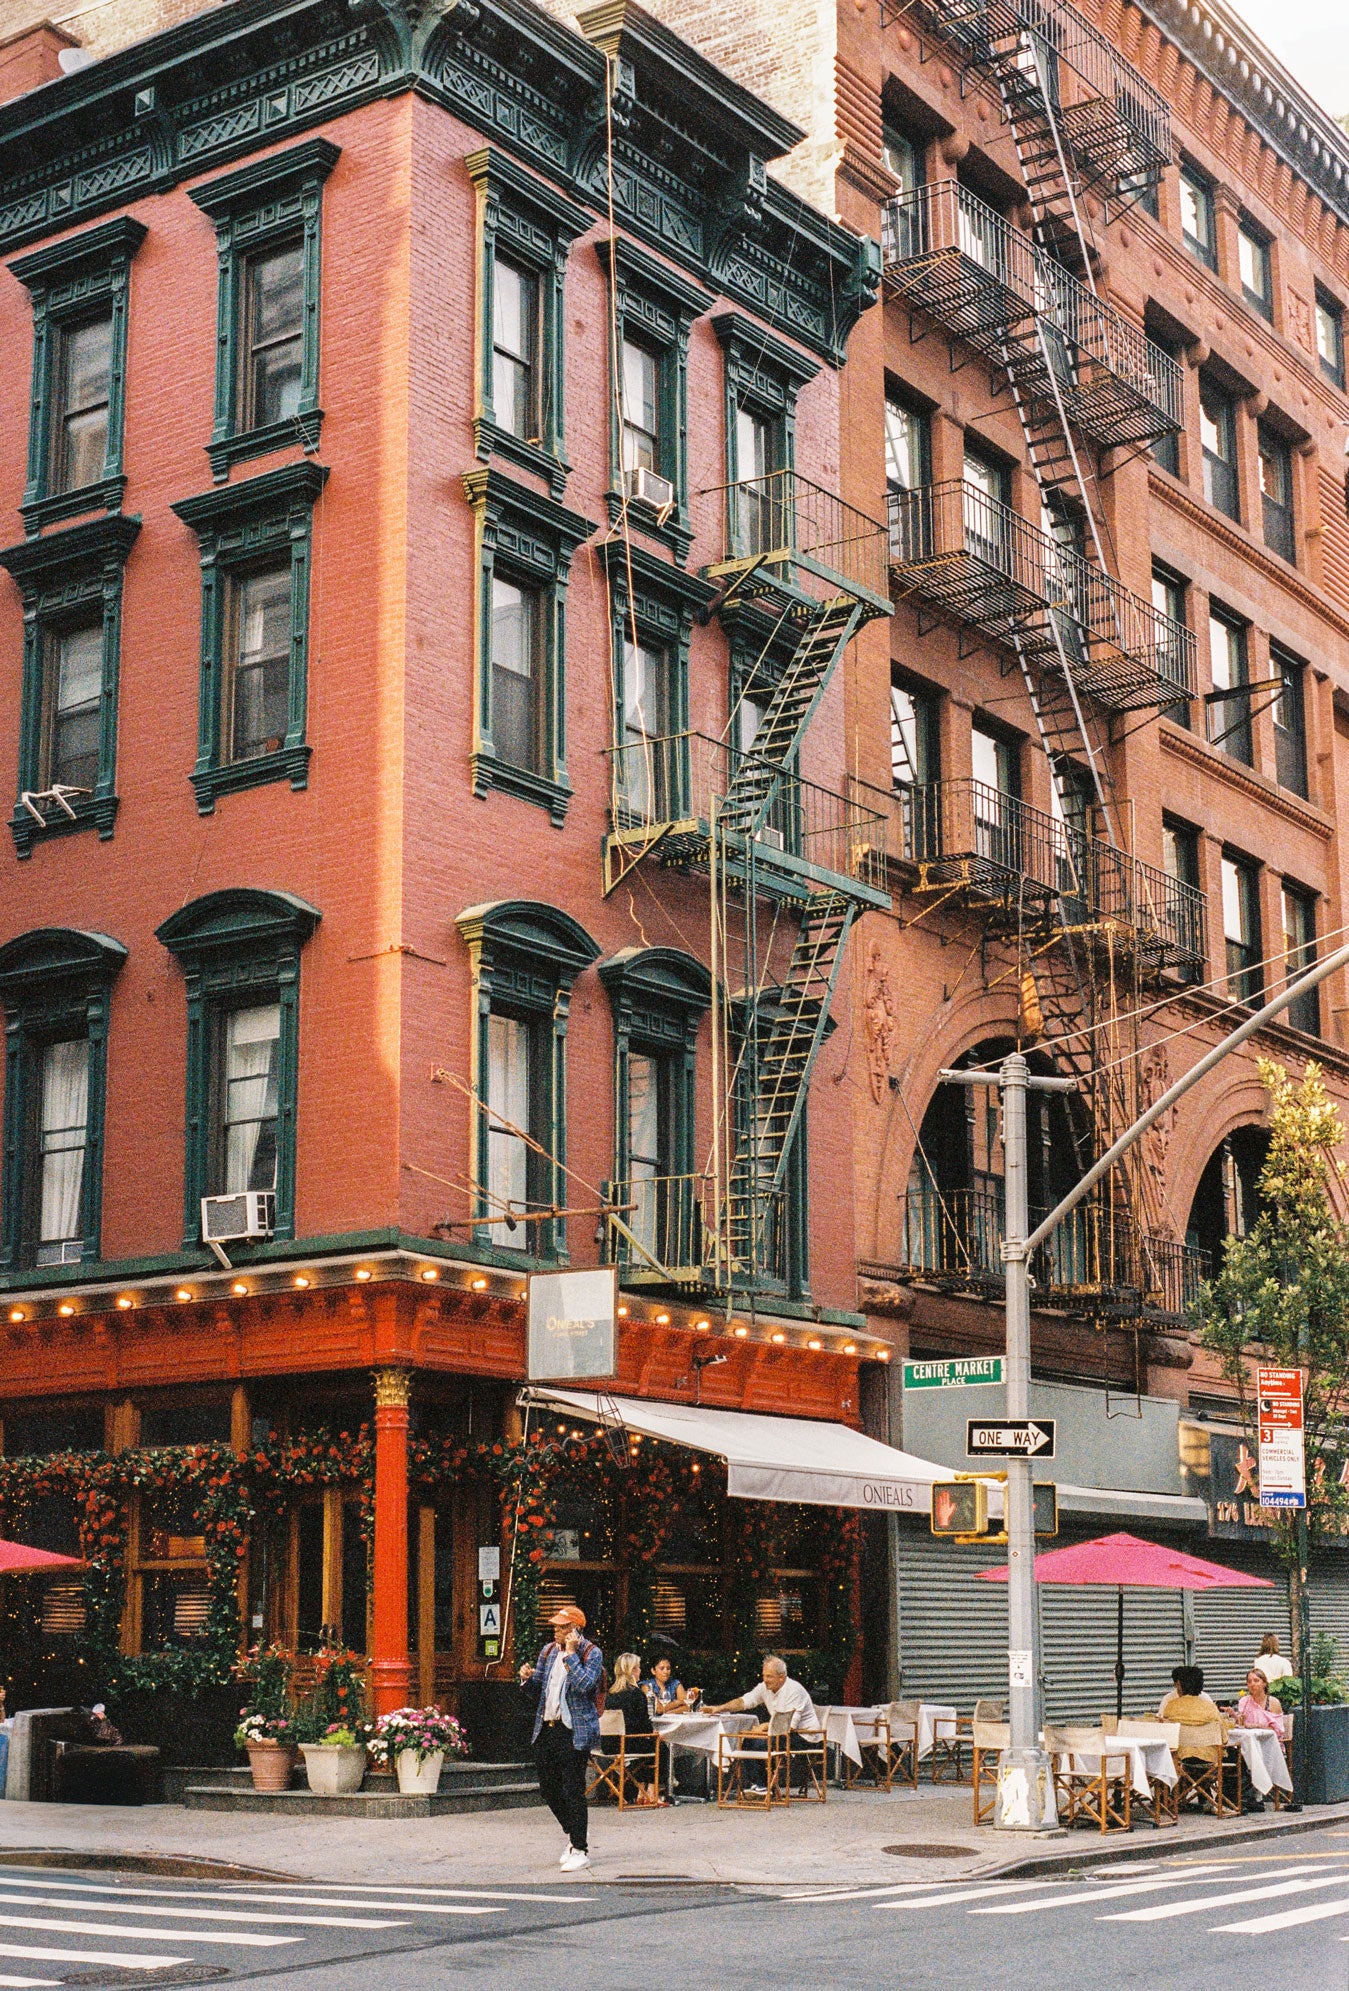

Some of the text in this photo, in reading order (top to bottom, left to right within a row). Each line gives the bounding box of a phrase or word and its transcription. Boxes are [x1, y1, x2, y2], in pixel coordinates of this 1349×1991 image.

[913, 1360, 995, 1380] CENTRE MARKET
[941, 1376, 967, 1385] PLACE
[979, 1431, 1040, 1446] ONE WAY
[1264, 1430, 1270, 1442] 3
[863, 1484, 913, 1507] ONIEALS
[1262, 1497, 1288, 1505] 104494
[484, 1608, 496, 1626] A
